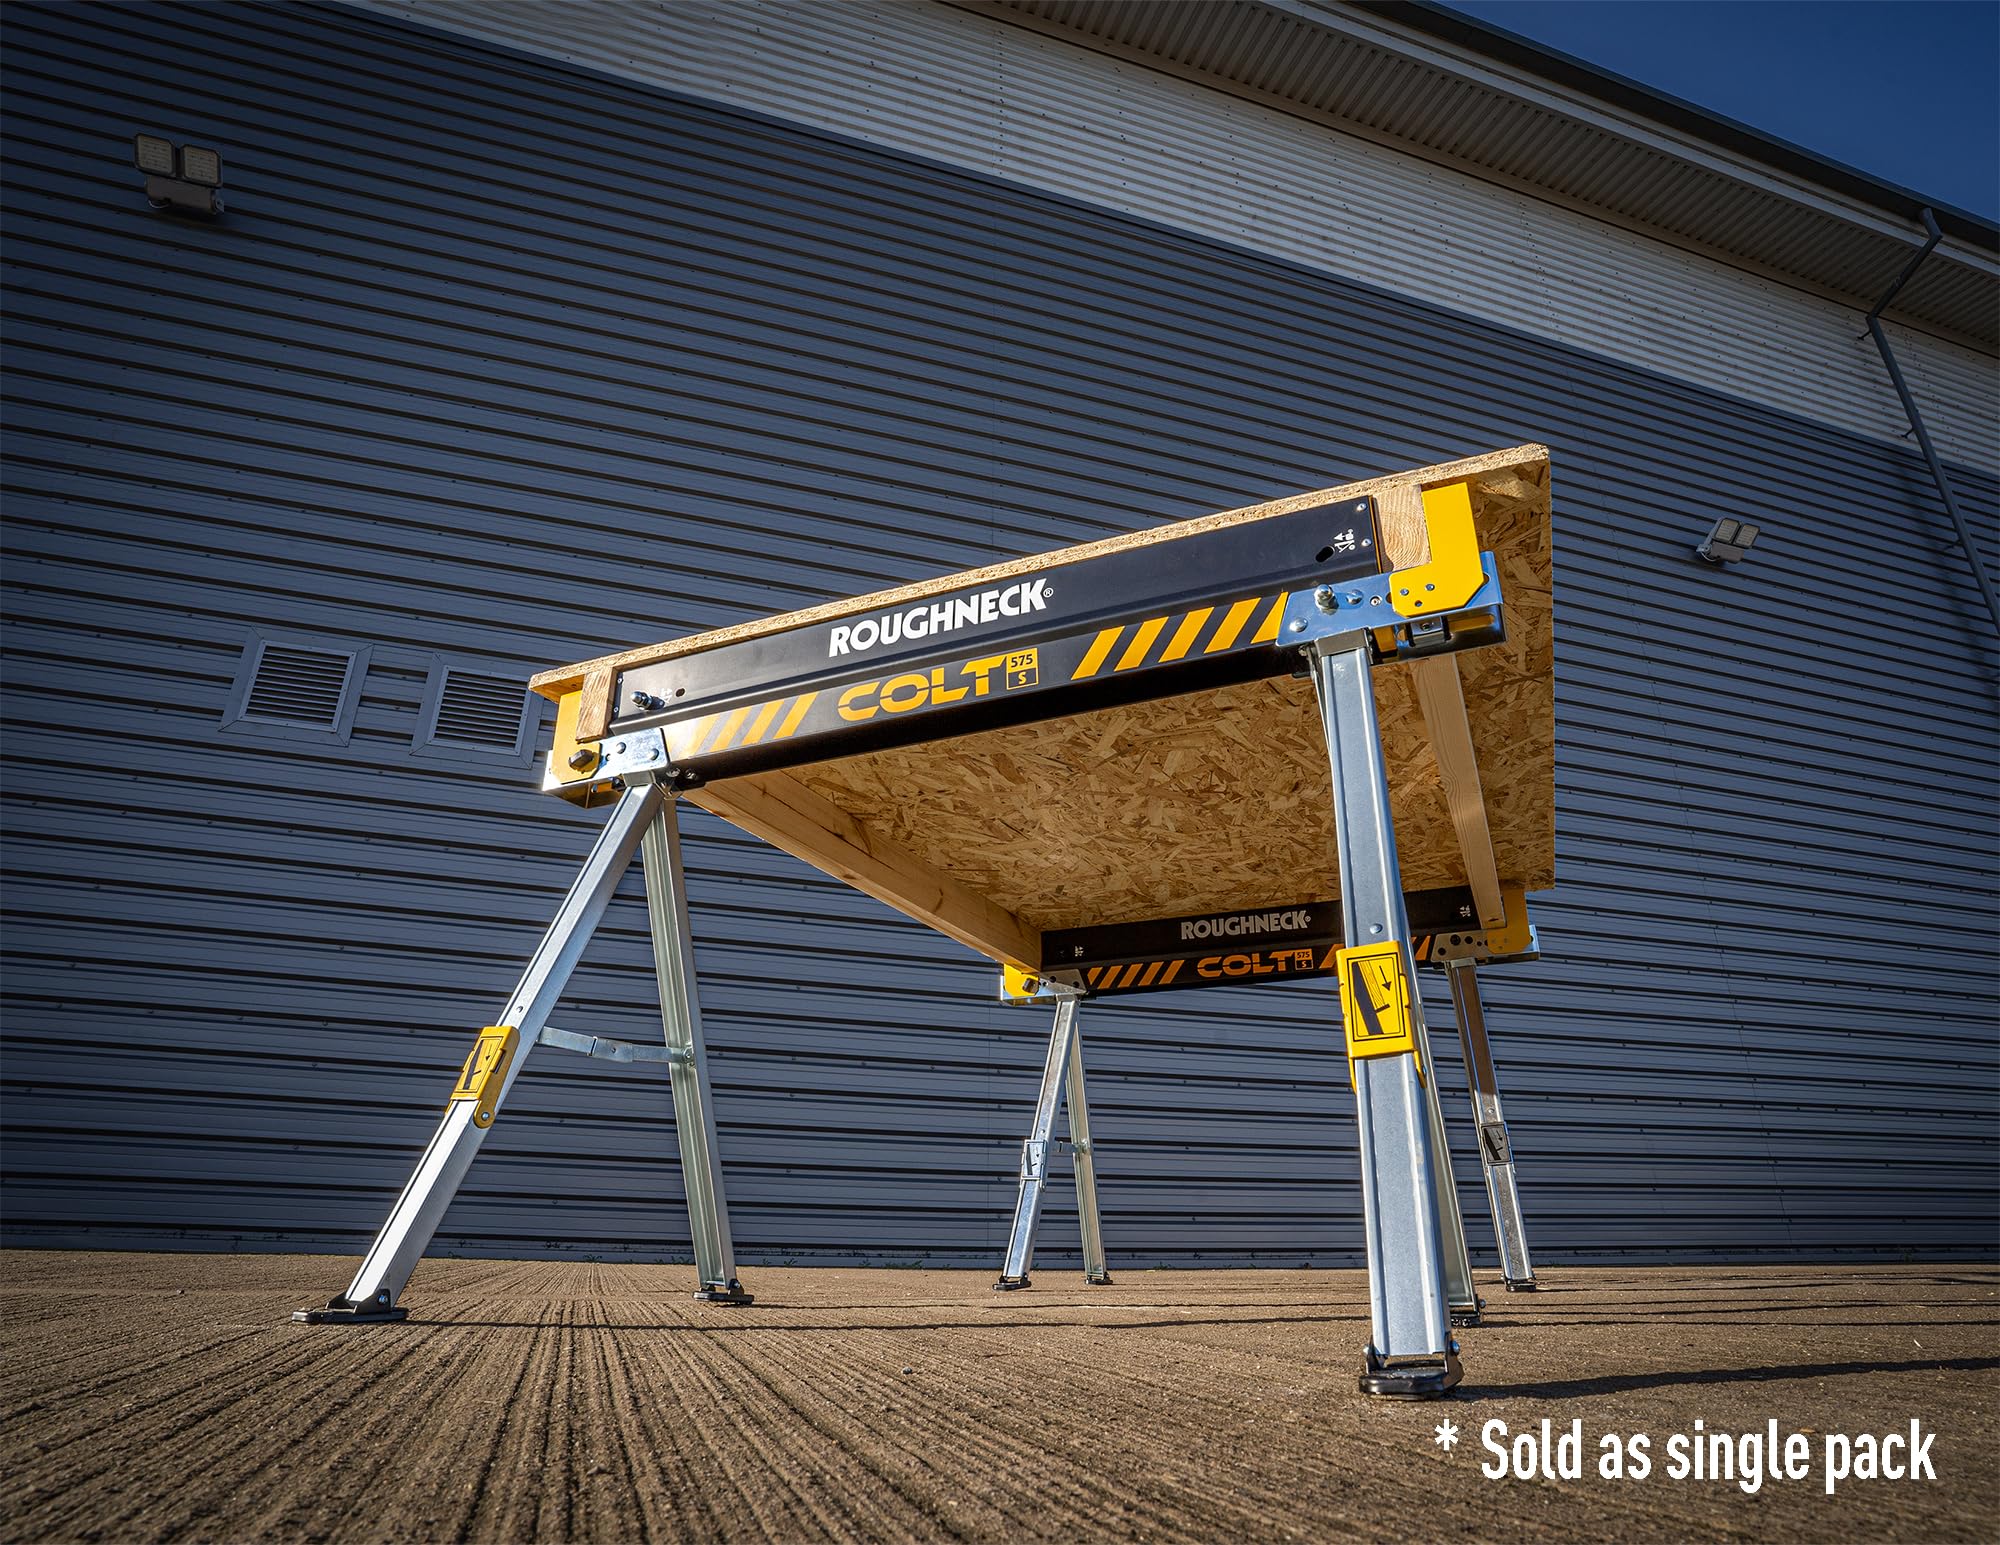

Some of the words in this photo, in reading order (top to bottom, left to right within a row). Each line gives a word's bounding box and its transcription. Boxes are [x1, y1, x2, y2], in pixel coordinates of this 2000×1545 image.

[837, 655, 1008, 722] COLT
[1010, 653, 1034, 669] 575
[1018, 672, 1027, 685] S
[1196, 950, 1296, 979] COLT
